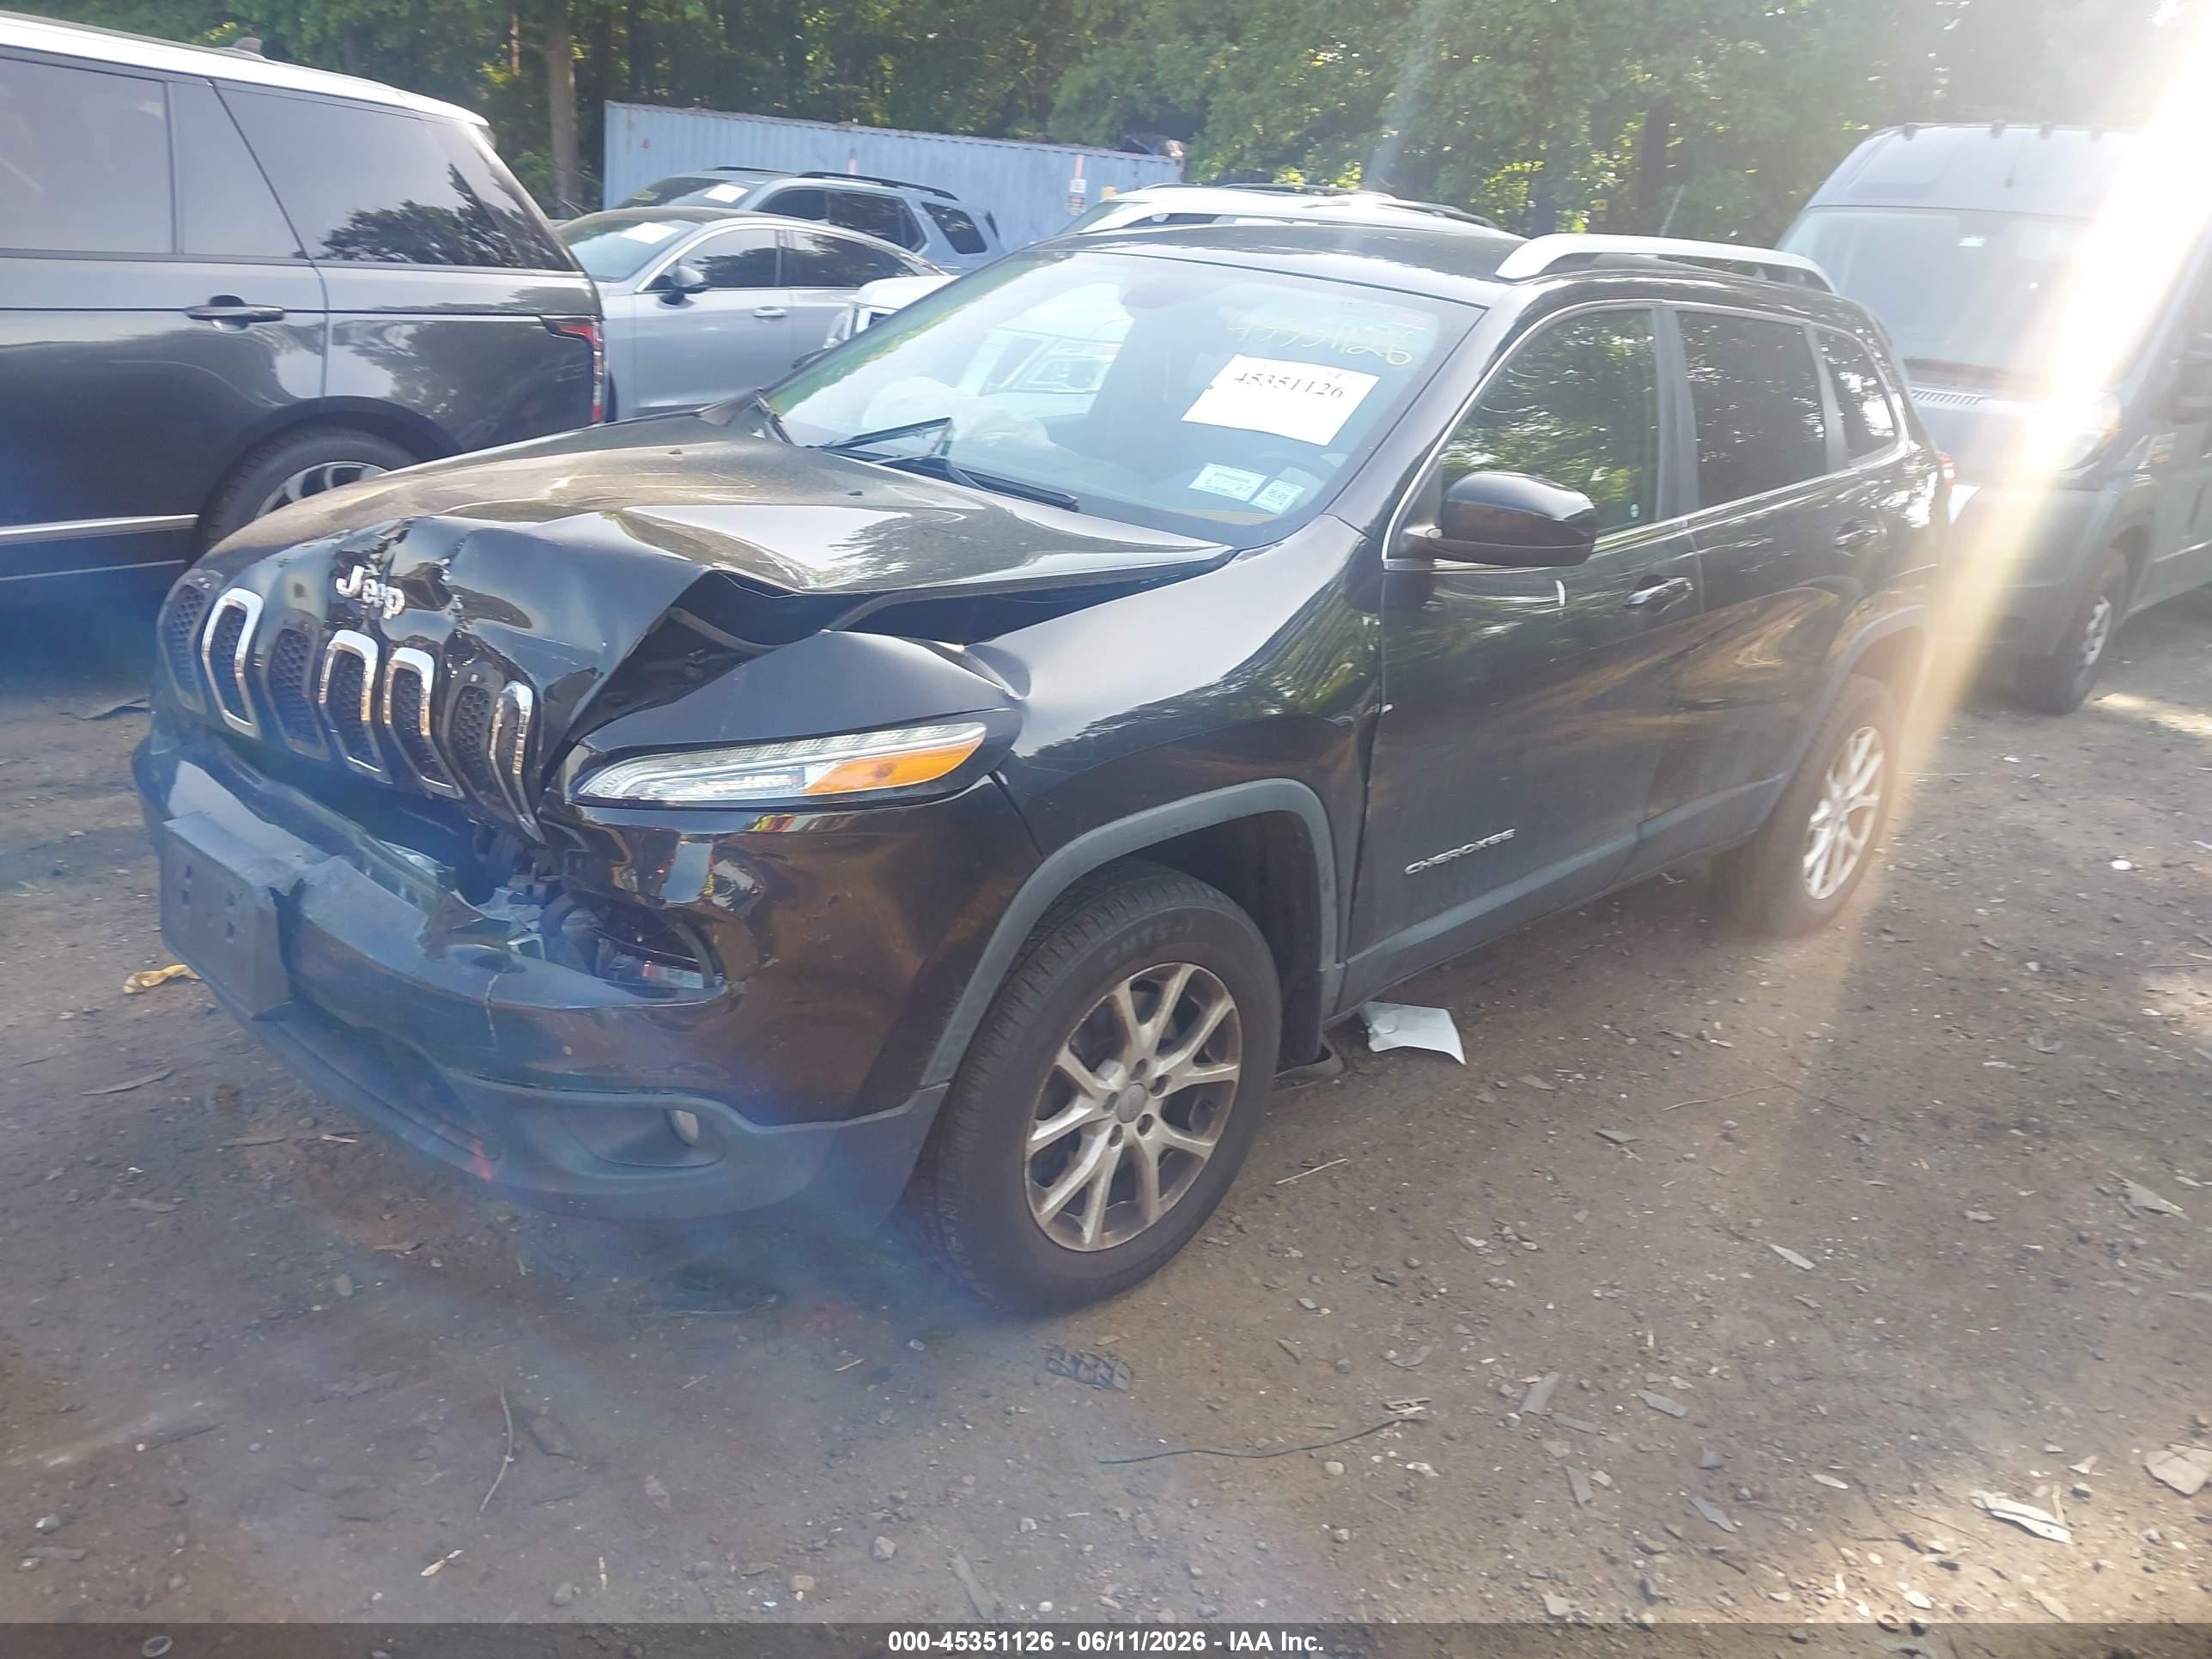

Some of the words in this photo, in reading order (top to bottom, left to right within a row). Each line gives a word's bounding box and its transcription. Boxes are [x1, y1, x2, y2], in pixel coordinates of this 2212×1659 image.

[1233, 372, 1345, 399] 45351126
[336, 564, 405, 619] Jeep
[1404, 828, 1516, 876] CHEROKEE
